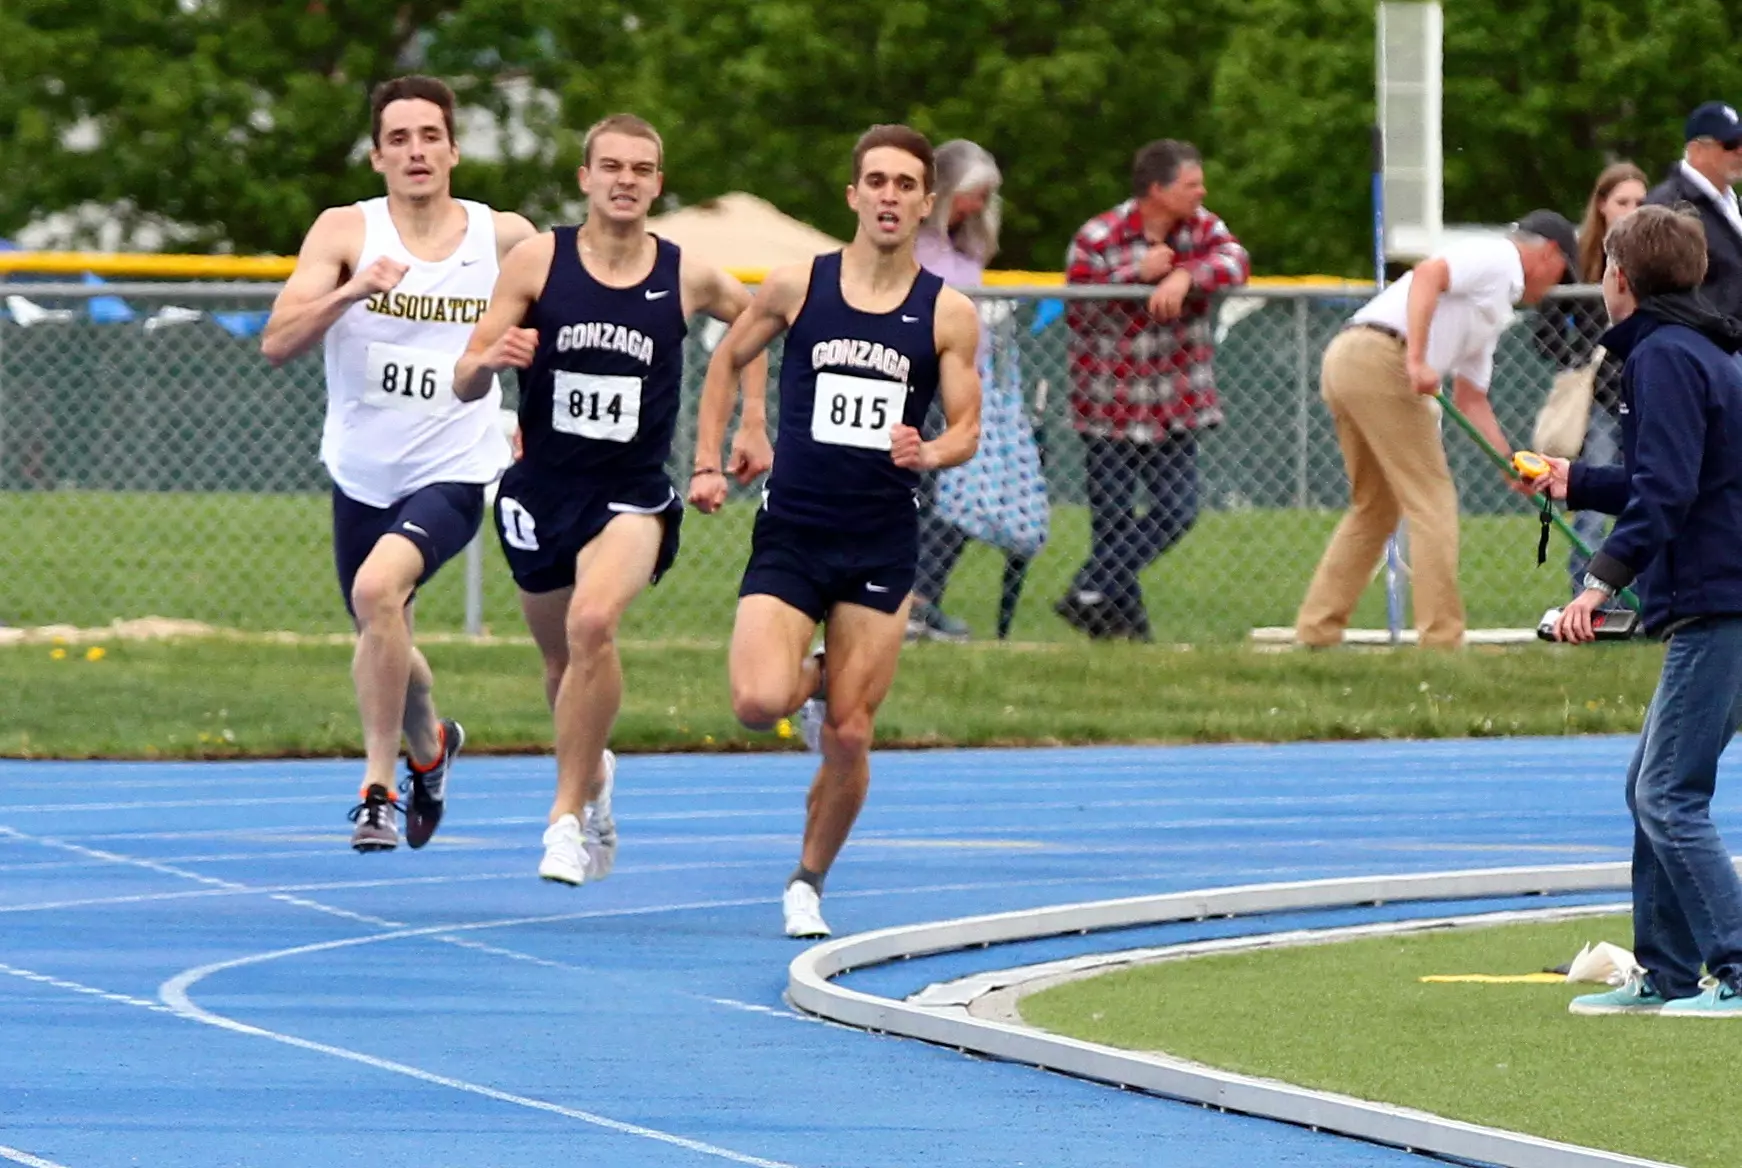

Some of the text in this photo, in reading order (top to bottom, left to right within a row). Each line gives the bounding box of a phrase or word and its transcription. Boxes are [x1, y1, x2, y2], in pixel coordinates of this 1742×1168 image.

[366, 291, 487, 323] SASQUATCH
[556, 321, 654, 366] GONZAGA
[812, 338, 910, 383] GONZAGA
[382, 362, 437, 400] 816
[569, 389, 622, 424] 814
[830, 392, 889, 430] 815
